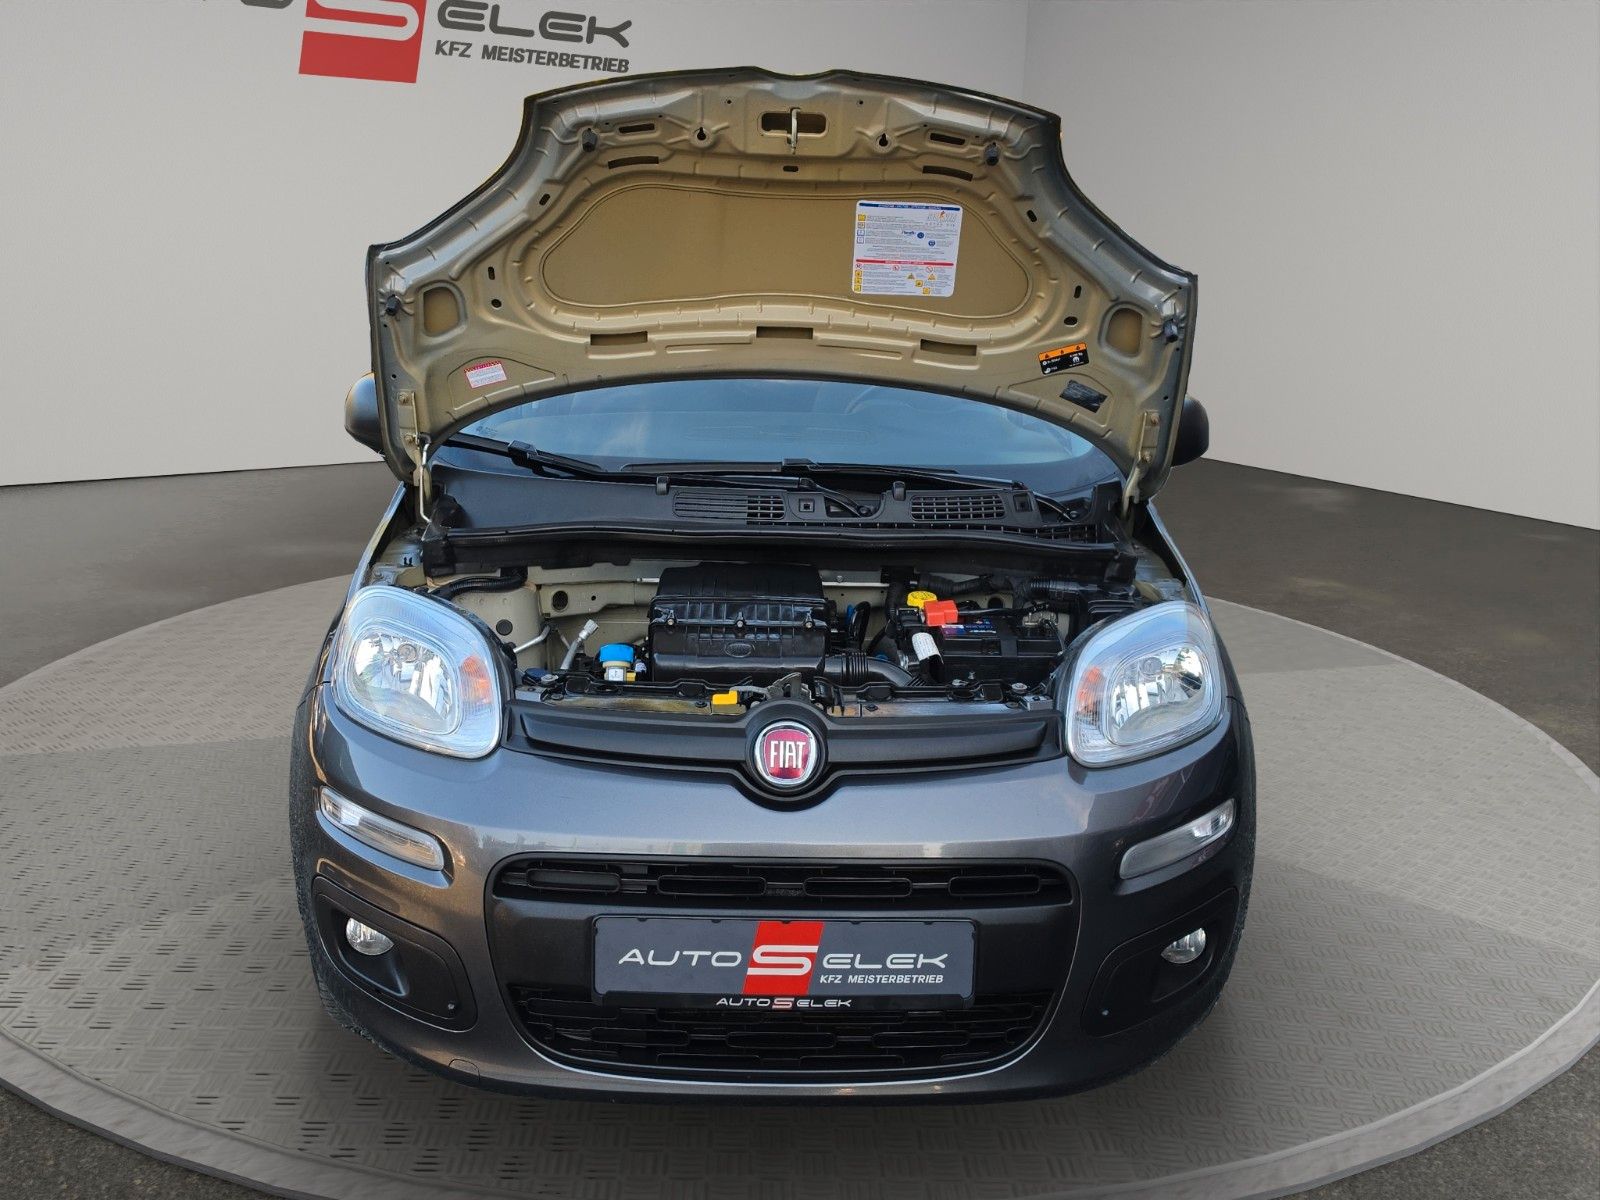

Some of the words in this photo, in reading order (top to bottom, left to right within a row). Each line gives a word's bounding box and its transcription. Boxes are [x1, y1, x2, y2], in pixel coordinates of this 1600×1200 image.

[435, 40, 471, 59] KFZ
[481, 44, 630, 74] MEISTERBETRIEB
[770, 740, 806, 768] FIAT
[618, 948, 742, 967] AUTO
[819, 974, 842, 984] KFZ
[847, 974, 943, 985] MEISTERBETRIEB
[716, 998, 770, 1007] AUTO
